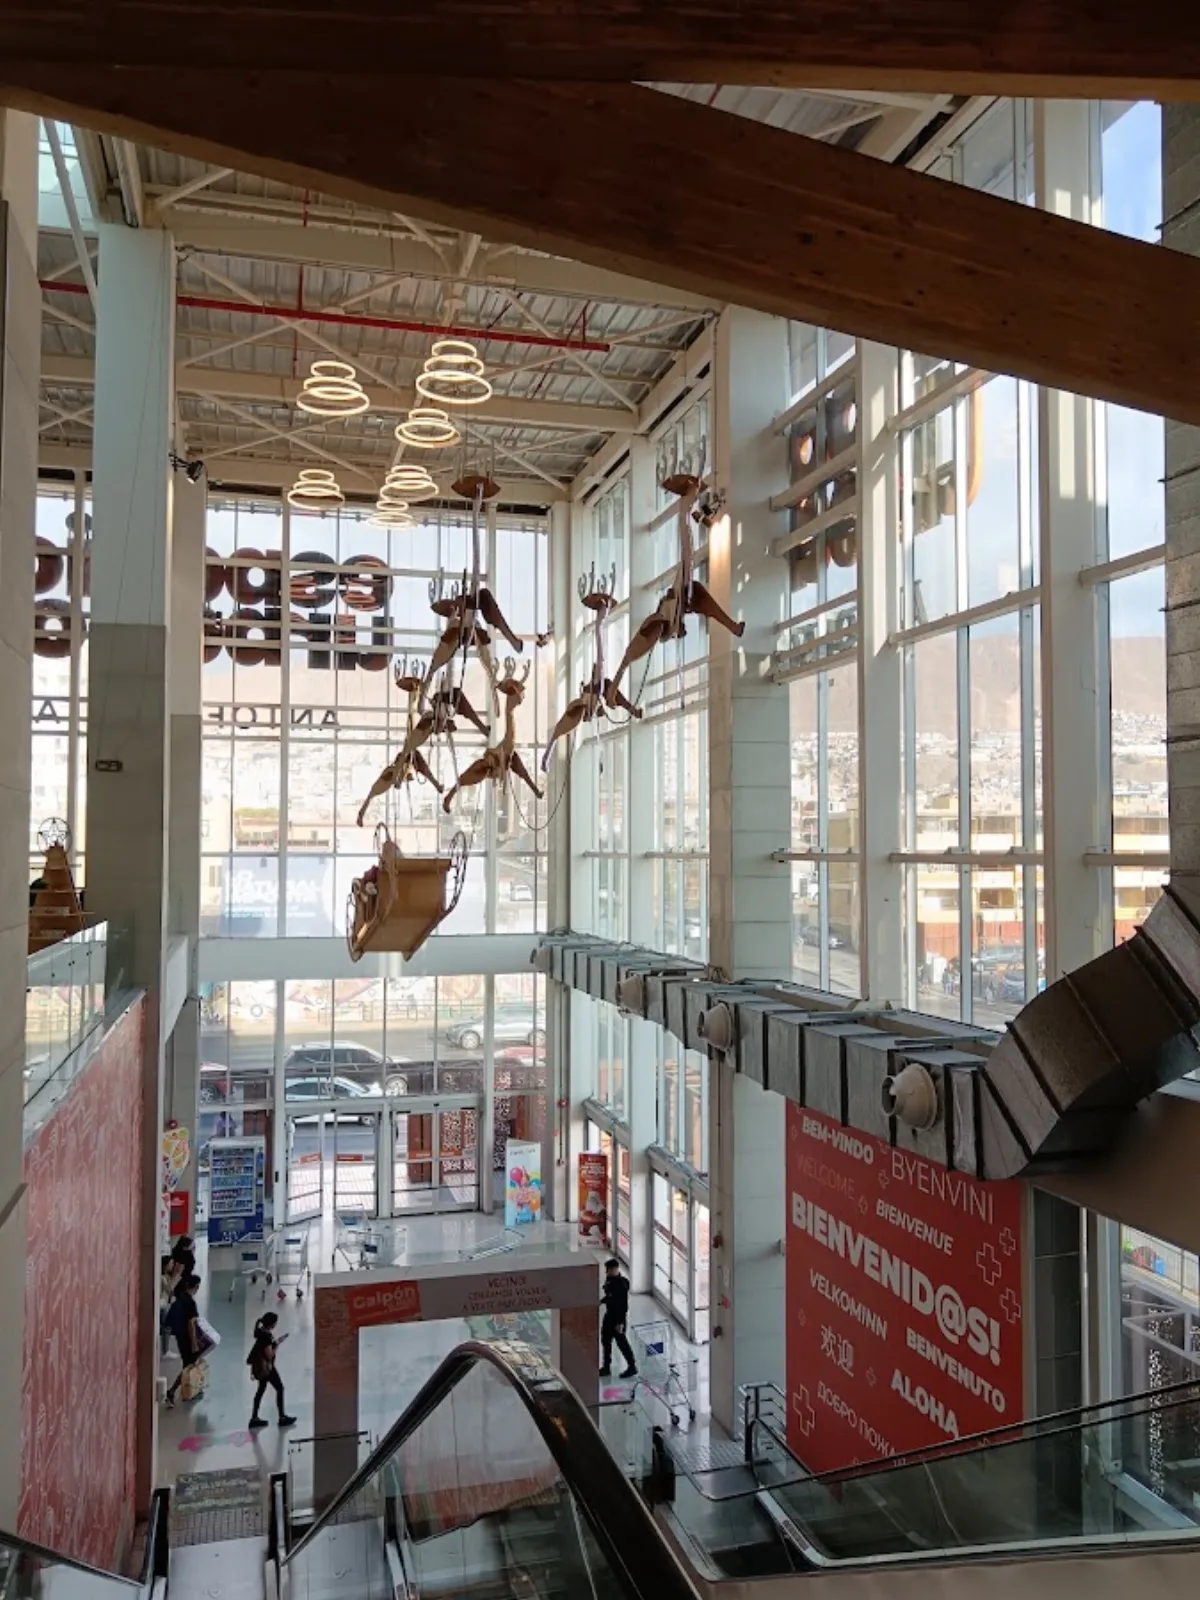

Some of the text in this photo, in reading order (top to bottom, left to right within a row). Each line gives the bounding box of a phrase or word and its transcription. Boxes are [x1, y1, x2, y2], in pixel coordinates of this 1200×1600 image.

[796, 1153, 856, 1200] WELCOME
[802, 1115, 874, 1165] BEM-VINDO
[891, 1151, 993, 1225] BYENVINI
[876, 1199, 954, 1255] BIENVENUE
[792, 1190, 1000, 1367] BIENVENID@S!
[810, 1268, 888, 1341] VELKOMINN
[820, 1324, 855, 1378] 欢迎
[906, 1327, 1006, 1413] BENVENUTO
[891, 1368, 960, 1441] ALOHA
